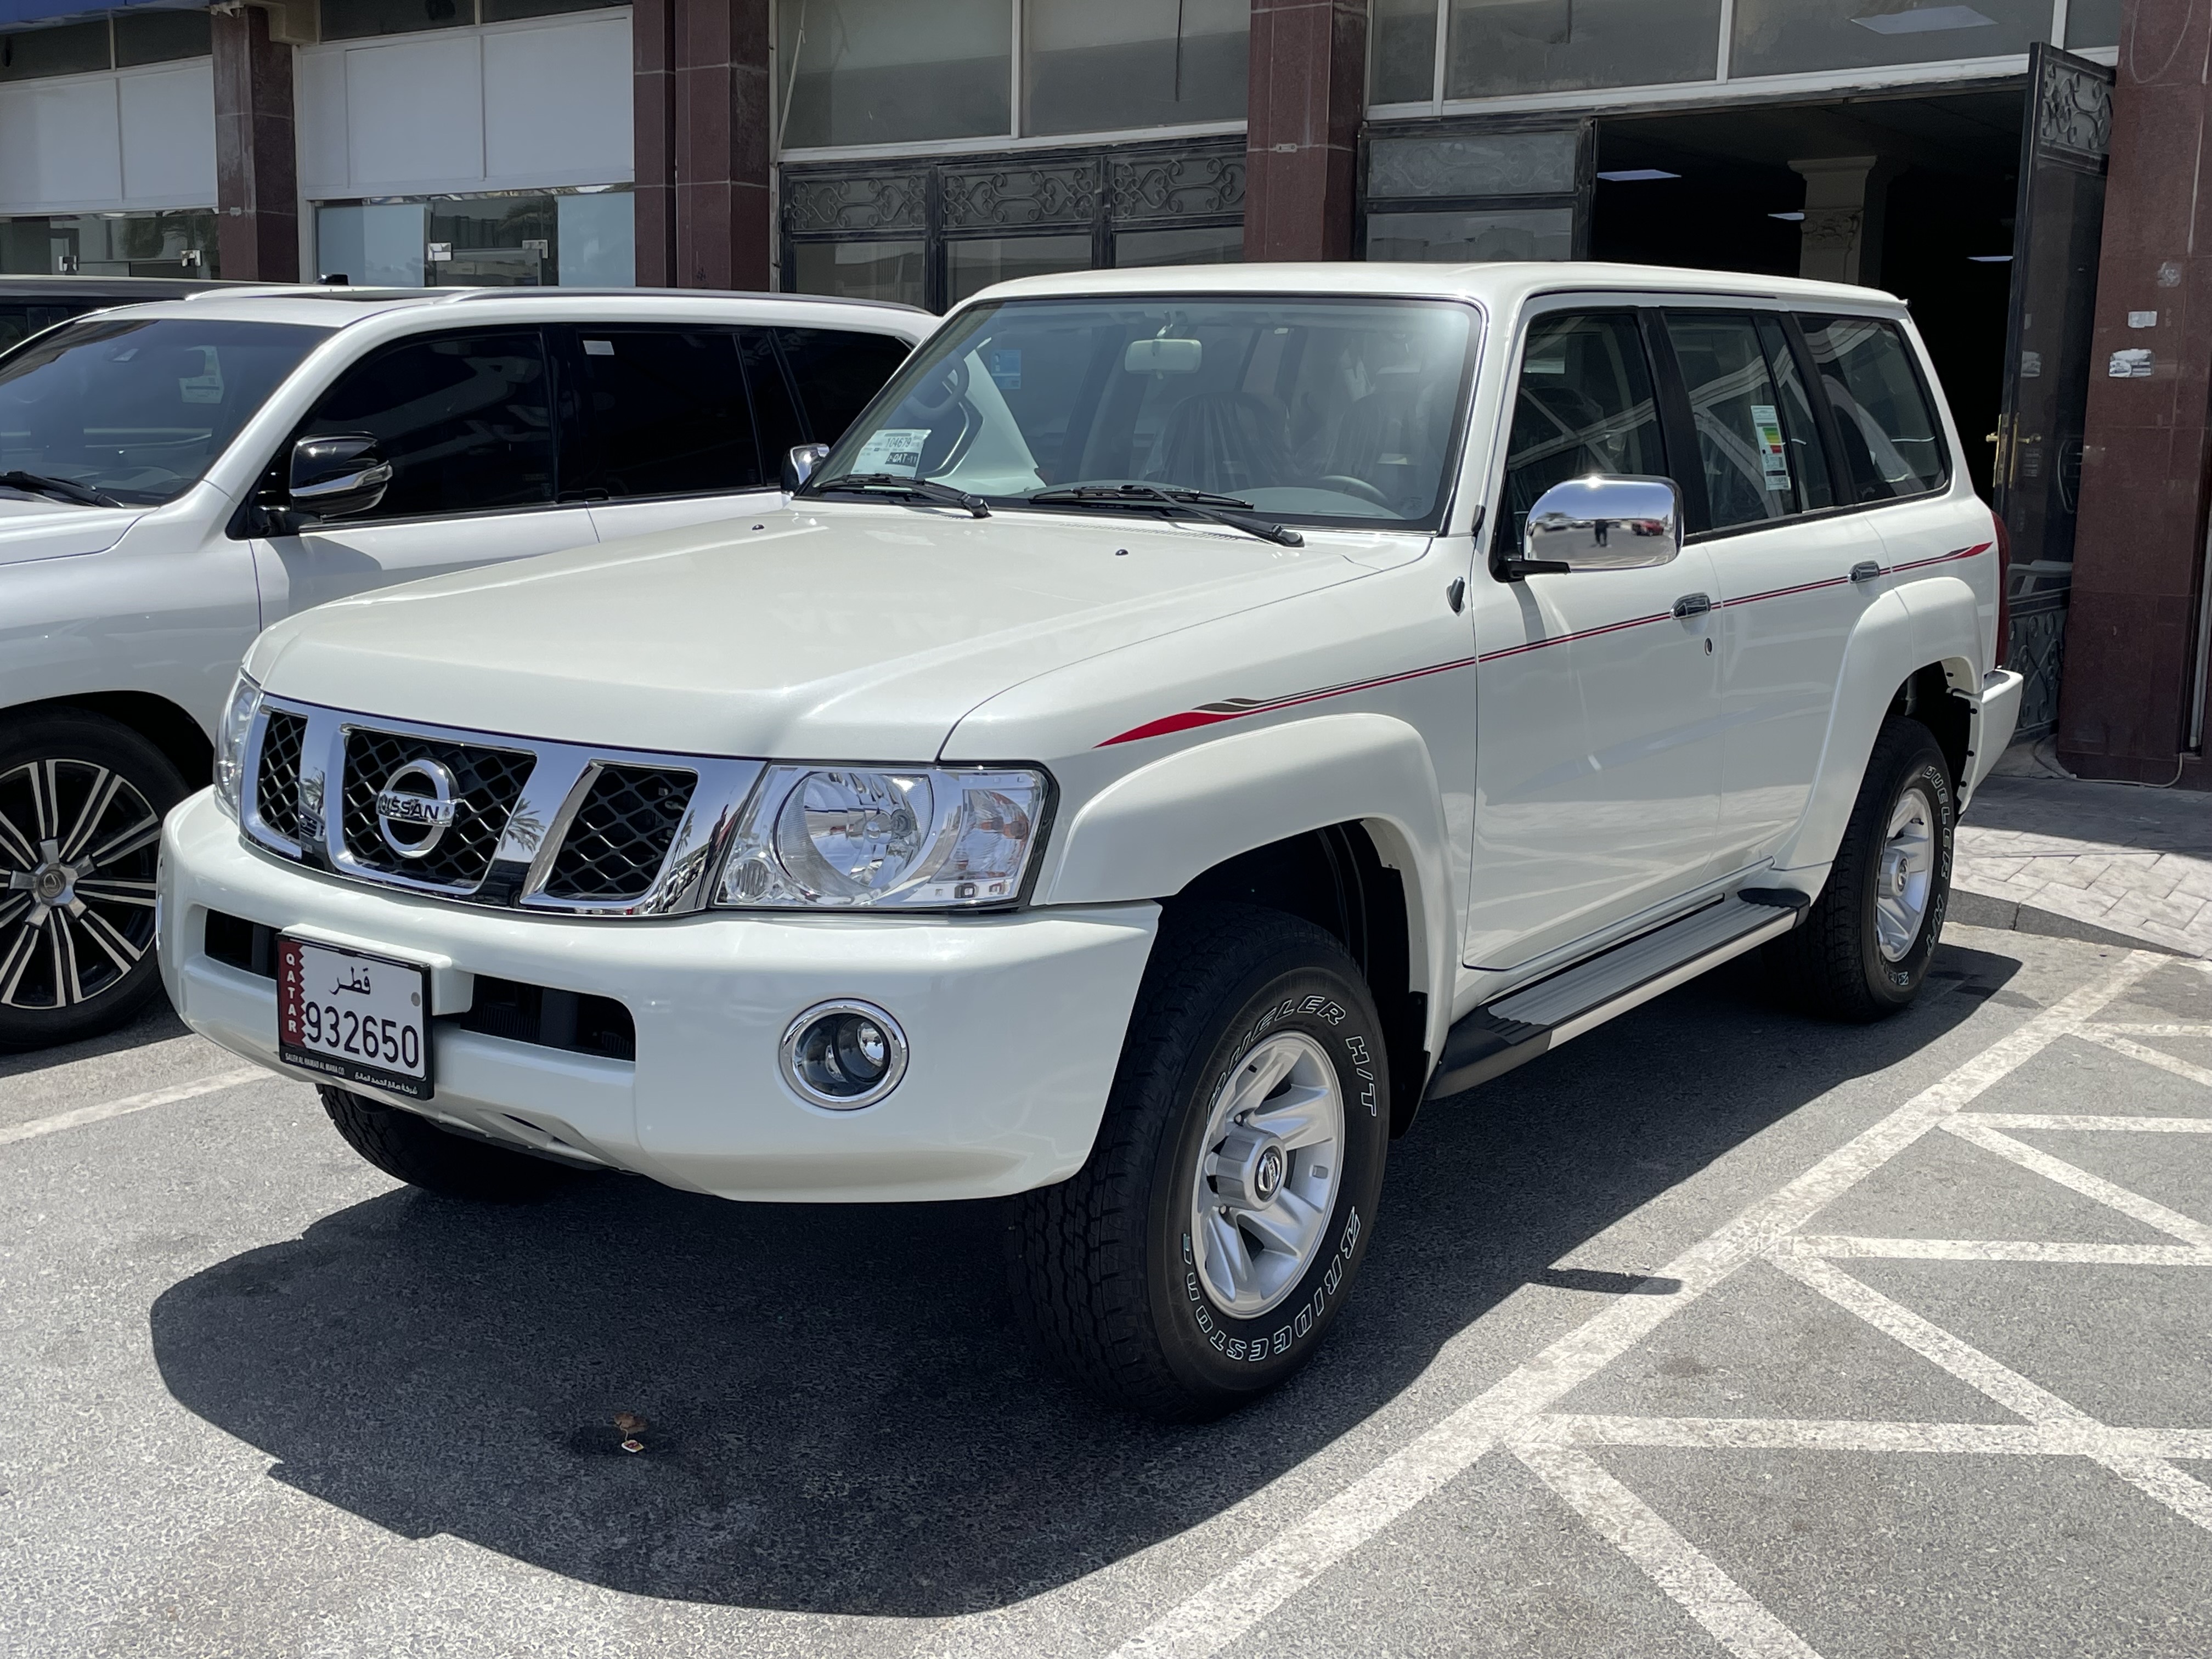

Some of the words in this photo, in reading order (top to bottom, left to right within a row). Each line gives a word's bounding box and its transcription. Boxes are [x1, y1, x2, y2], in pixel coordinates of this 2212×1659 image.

[379, 794, 440, 820] NISSAN
[286, 953, 297, 1034] QATAR
[329, 966, 371, 995] قطر
[306, 1001, 419, 1069] 932650
[1345, 1036, 1377, 1117] H/T
